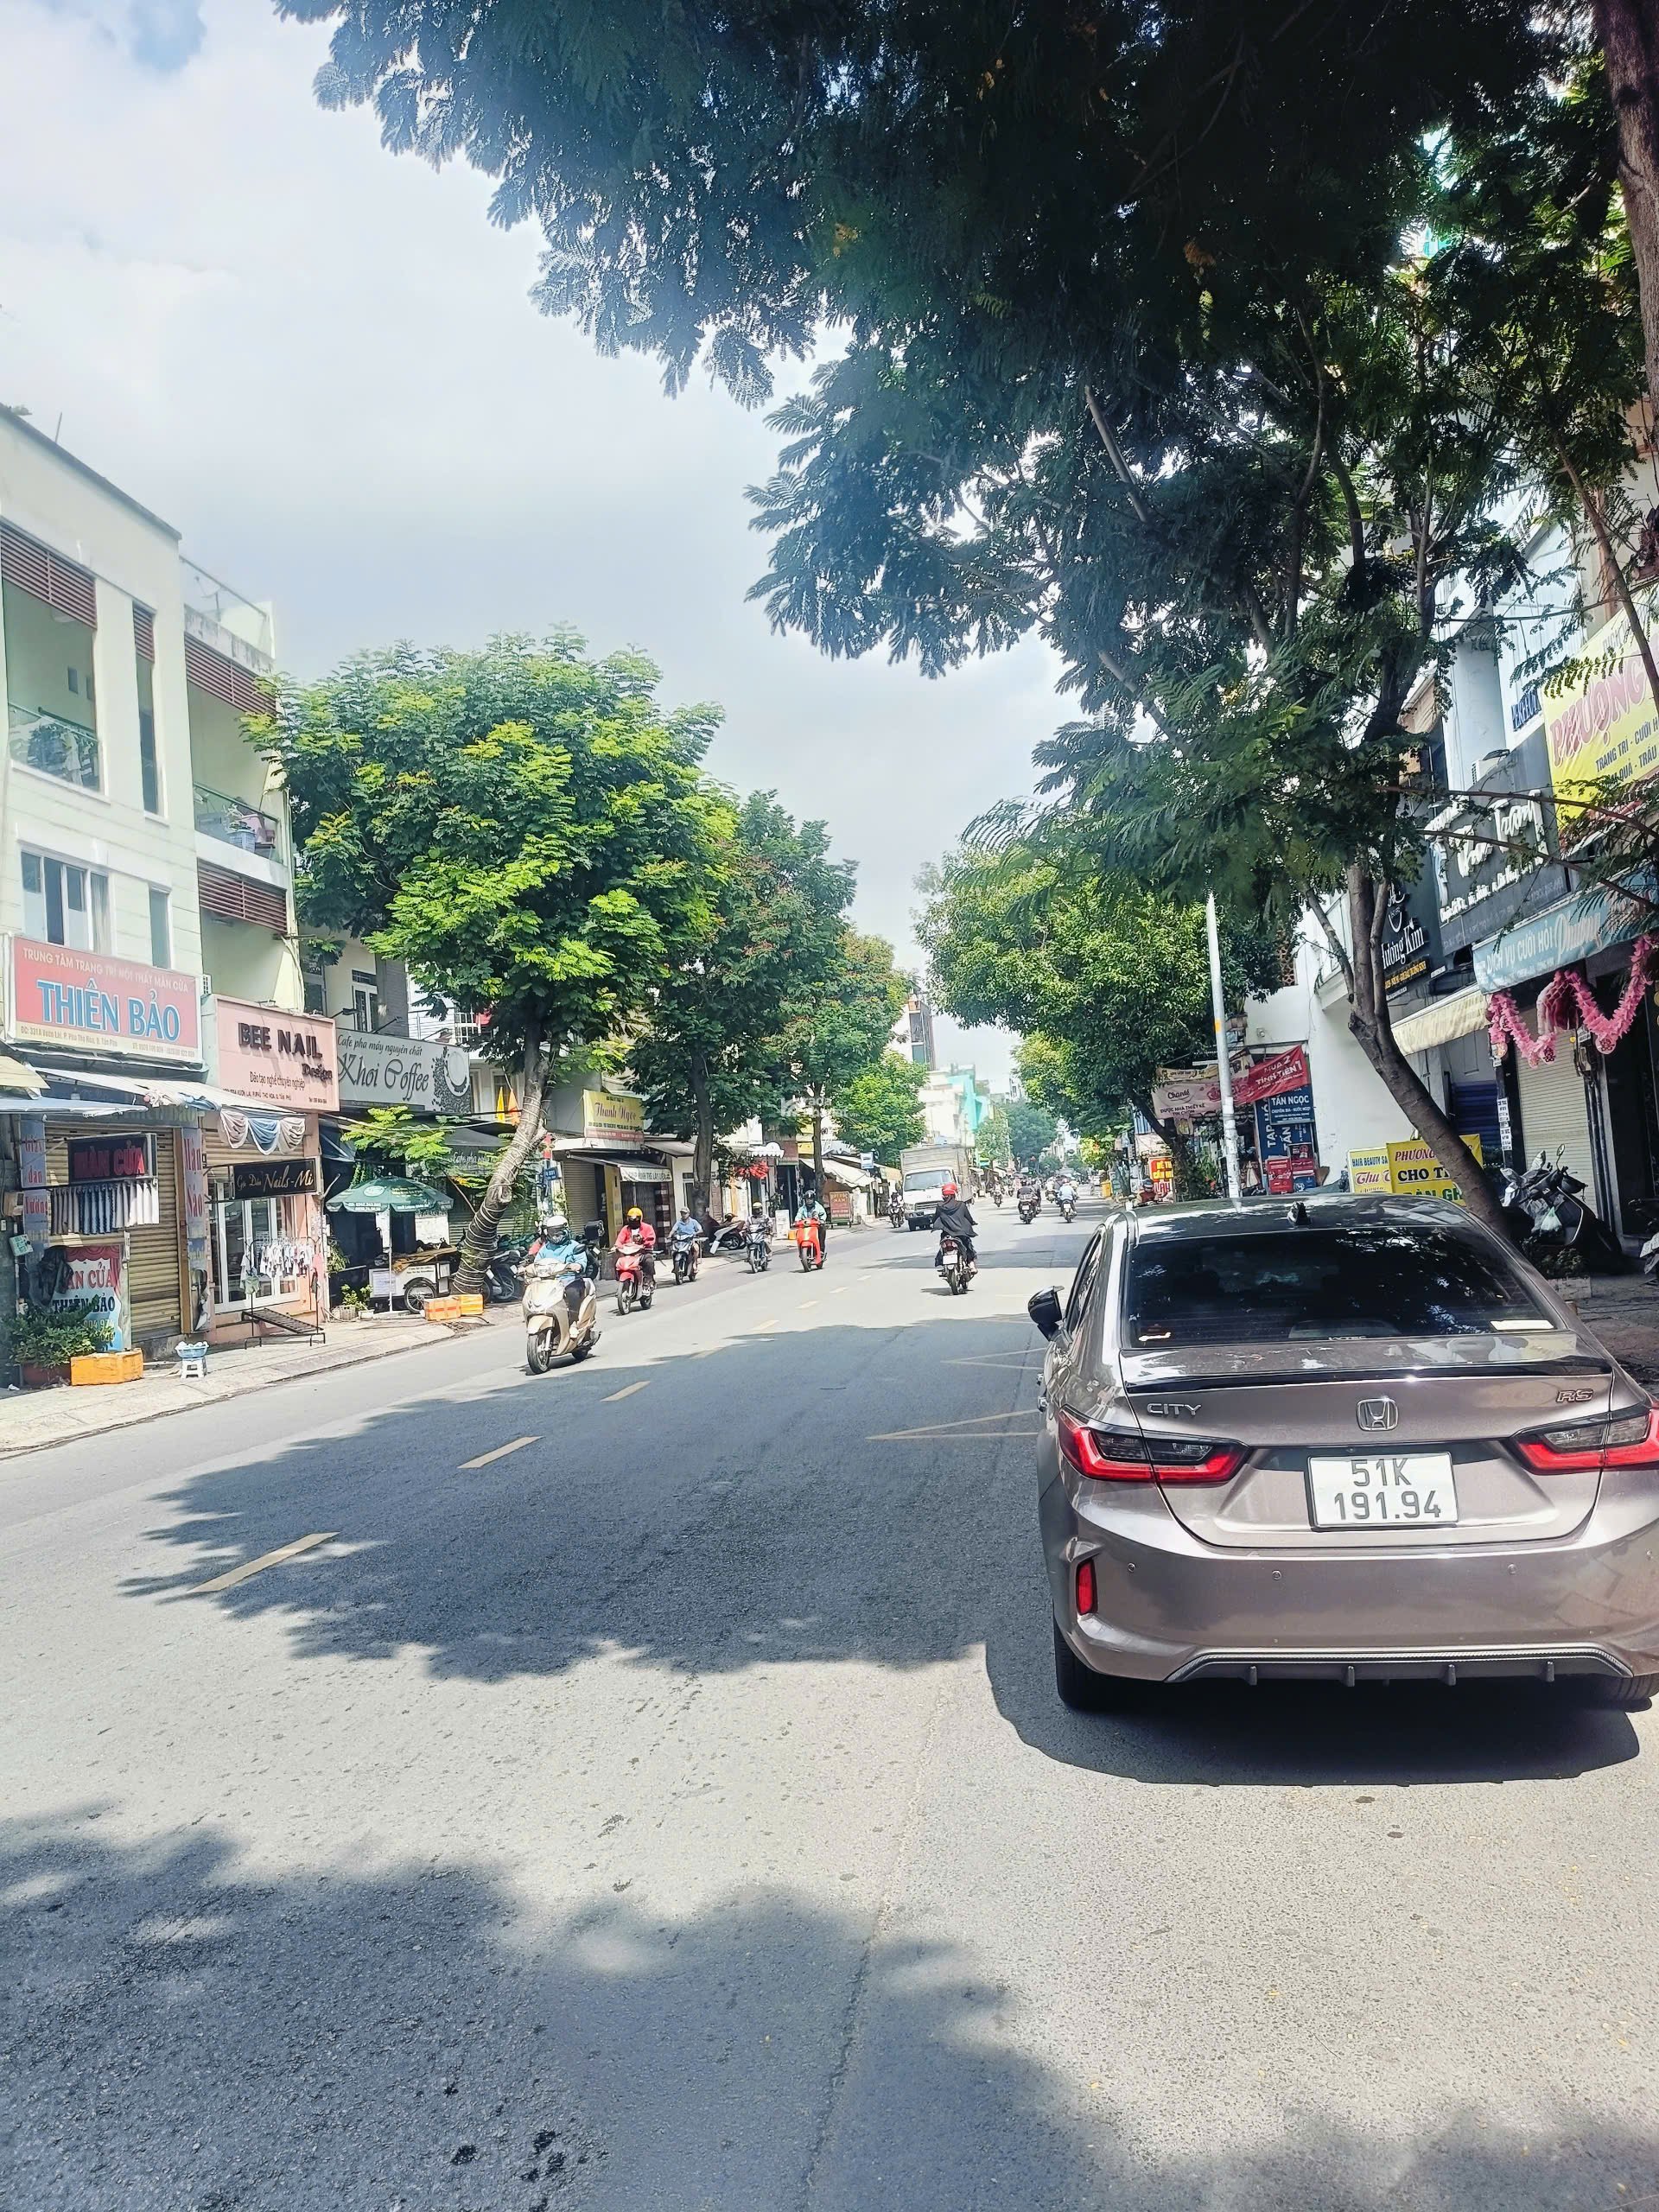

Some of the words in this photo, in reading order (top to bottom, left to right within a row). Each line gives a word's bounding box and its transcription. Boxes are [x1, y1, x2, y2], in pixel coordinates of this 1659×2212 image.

[1596, 747, 1617, 772] TRANG
[1618, 735, 1629, 756] TRÍ
[1634, 721, 1651, 745] CƯỚI
[1505, 946, 1516, 965] VỤ
[1538, 920, 1554, 951] HỎI
[23, 947, 54, 964] TRUNG
[55, 952, 73, 969] TÂM
[75, 958, 103, 974] TRANG
[154, 974, 171, 989] MÀN
[173, 977, 188, 993] CỬA
[37, 977, 120, 1033] THIÊN
[128, 988, 181, 1042] BẢO
[238, 1023, 271, 1051] BEE
[277, 1029, 322, 1059] NAIL
[337, 1034, 353, 1050] Cafe
[354, 1039, 367, 1052] pha
[368, 1039, 384, 1055] máy
[385, 1044, 408, 1057] nguyên
[410, 1044, 423, 1057] chất
[302, 1064, 333, 1084] Design
[1264, 1062, 1282, 1073] MUA
[1283, 1055, 1291, 1065] 2
[1295, 1060, 1302, 1071] 1
[385, 1058, 430, 1102] Coffee
[1271, 1094, 1287, 1106] TẤN
[1288, 1095, 1309, 1107] NGỌC
[1266, 1125, 1277, 1147] TẠP
[113, 1141, 144, 1176] CỬA
[1351, 1157, 1363, 1166] HAIR
[1364, 1156, 1381, 1166] BEAUTY
[1356, 1171, 1380, 1185] Thu
[1397, 1170, 1429, 1182] CHO
[88, 1262, 114, 1288] CỬA
[1555, 1388, 1594, 1403] RS
[1147, 1402, 1202, 1416] CITY
[1351, 1458, 1411, 1486] 51K
[1334, 1490, 1441, 1520] 191.94
